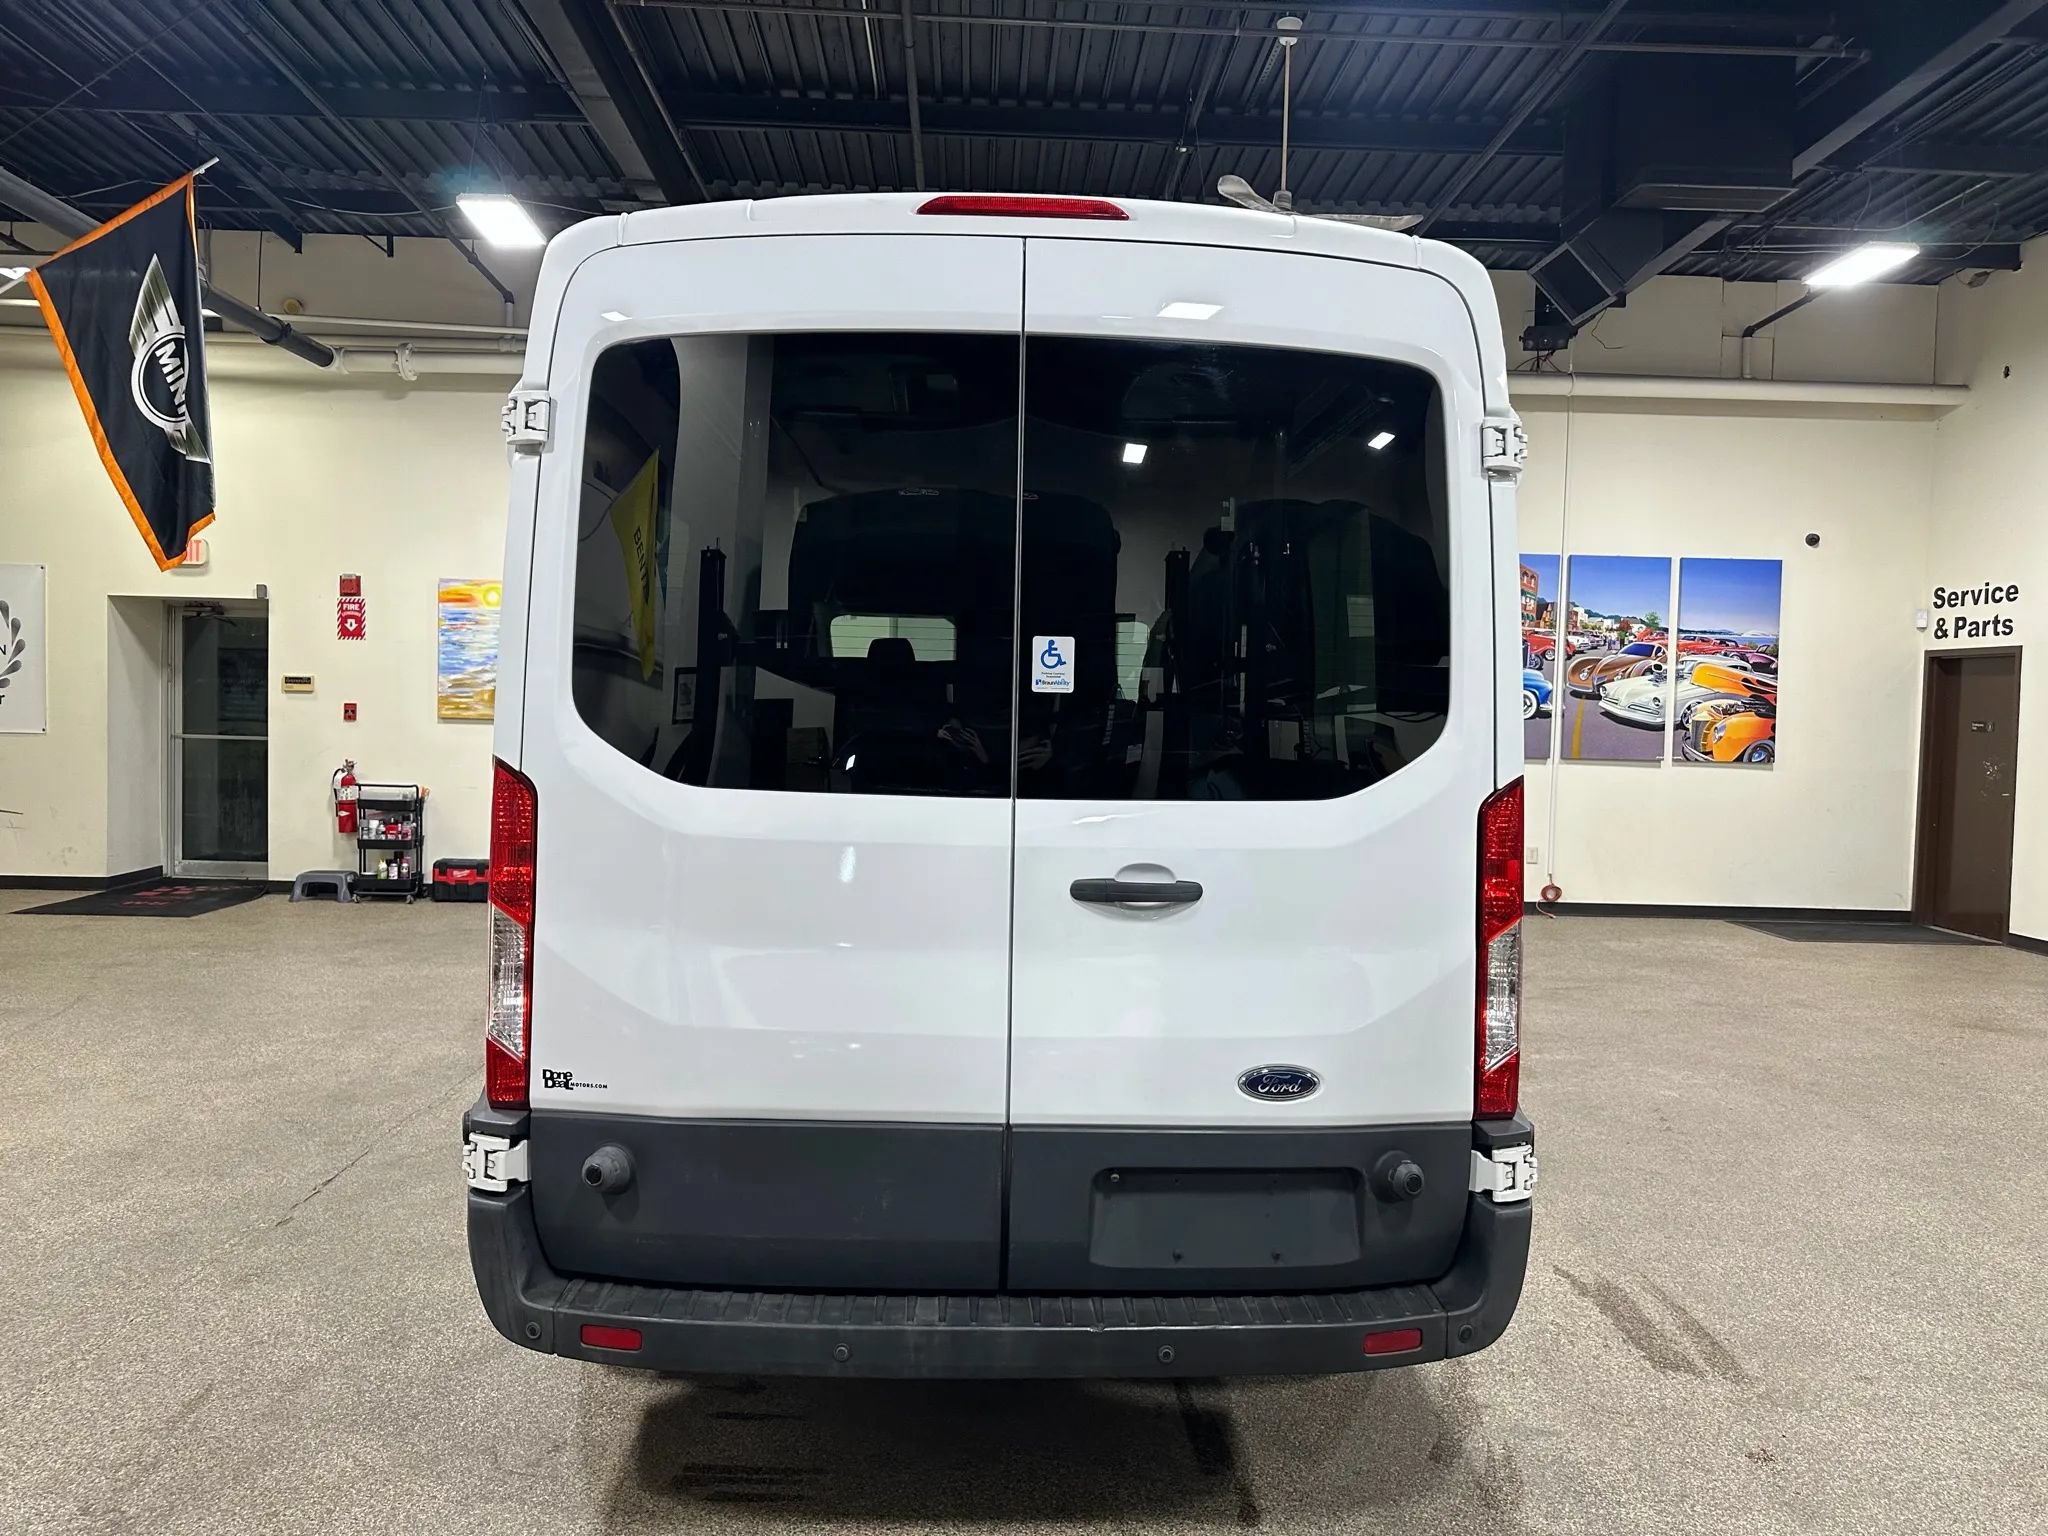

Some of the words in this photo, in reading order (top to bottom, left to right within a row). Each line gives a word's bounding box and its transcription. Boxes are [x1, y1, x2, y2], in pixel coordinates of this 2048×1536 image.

[185, 540, 202, 562] IT
[1932, 582, 2019, 609] Service
[342, 603, 360, 611] FIRE
[1933, 617, 1949, 640] &
[1953, 613, 2014, 638] Parts
[542, 1068, 573, 1081] Done
[1257, 1074, 1302, 1093] Ford
[570, 1081, 608, 1089] MOTORS.COM
